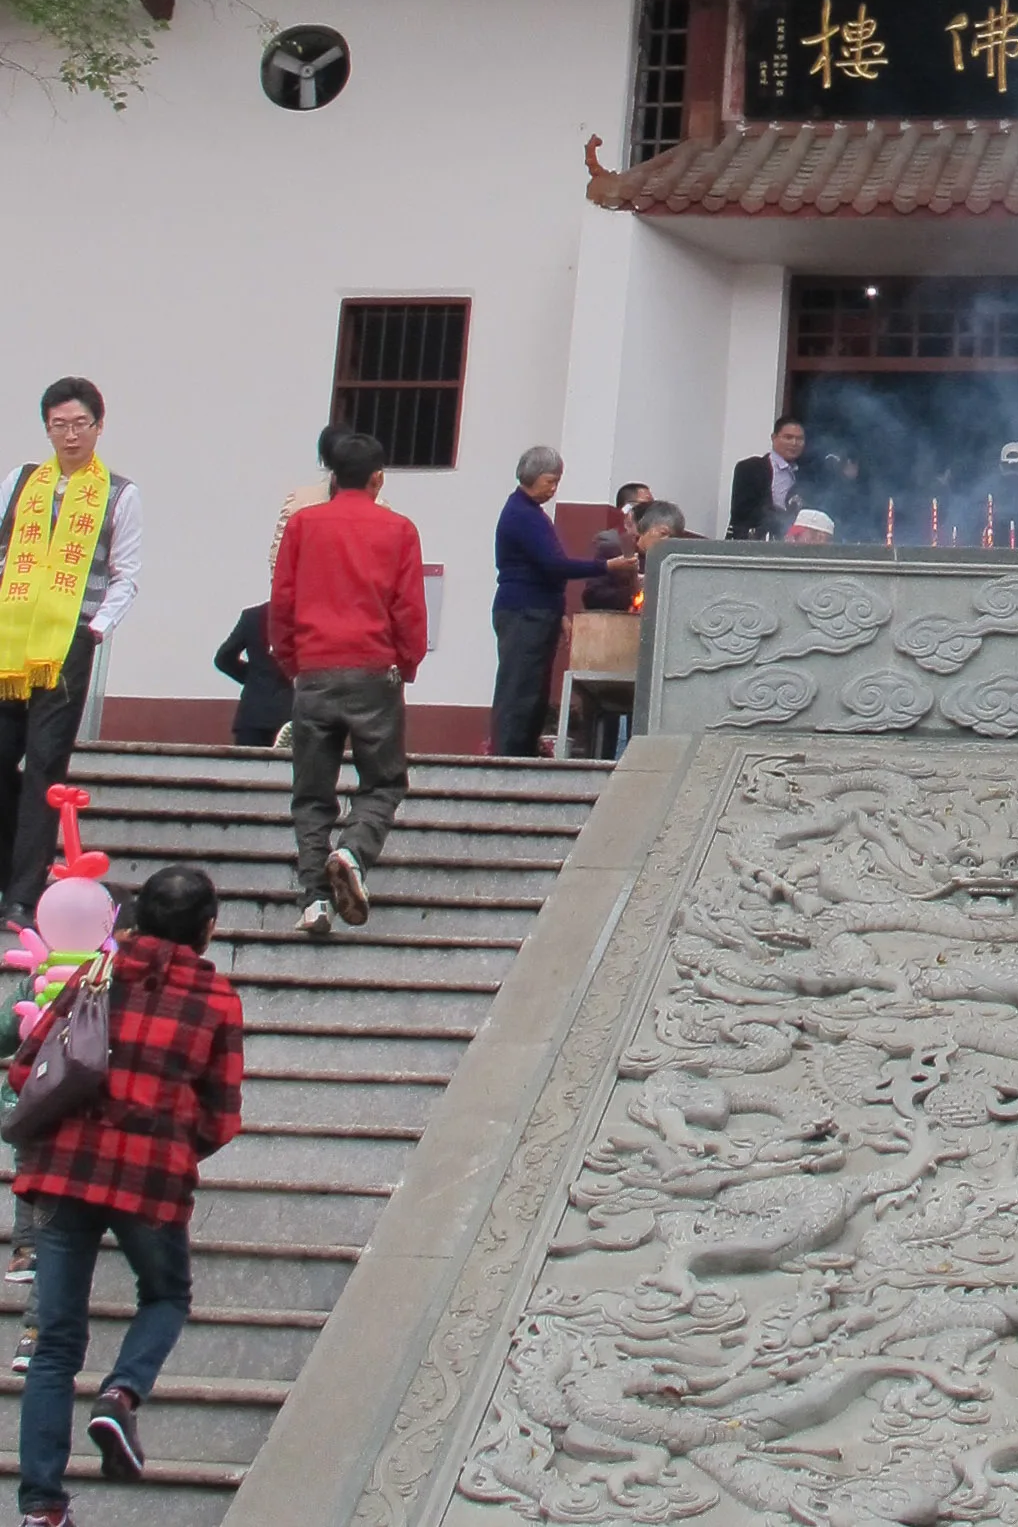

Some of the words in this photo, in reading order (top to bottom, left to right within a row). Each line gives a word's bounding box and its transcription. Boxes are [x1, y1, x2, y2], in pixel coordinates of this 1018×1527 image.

[4, 466, 53, 602] 定光佛普照
